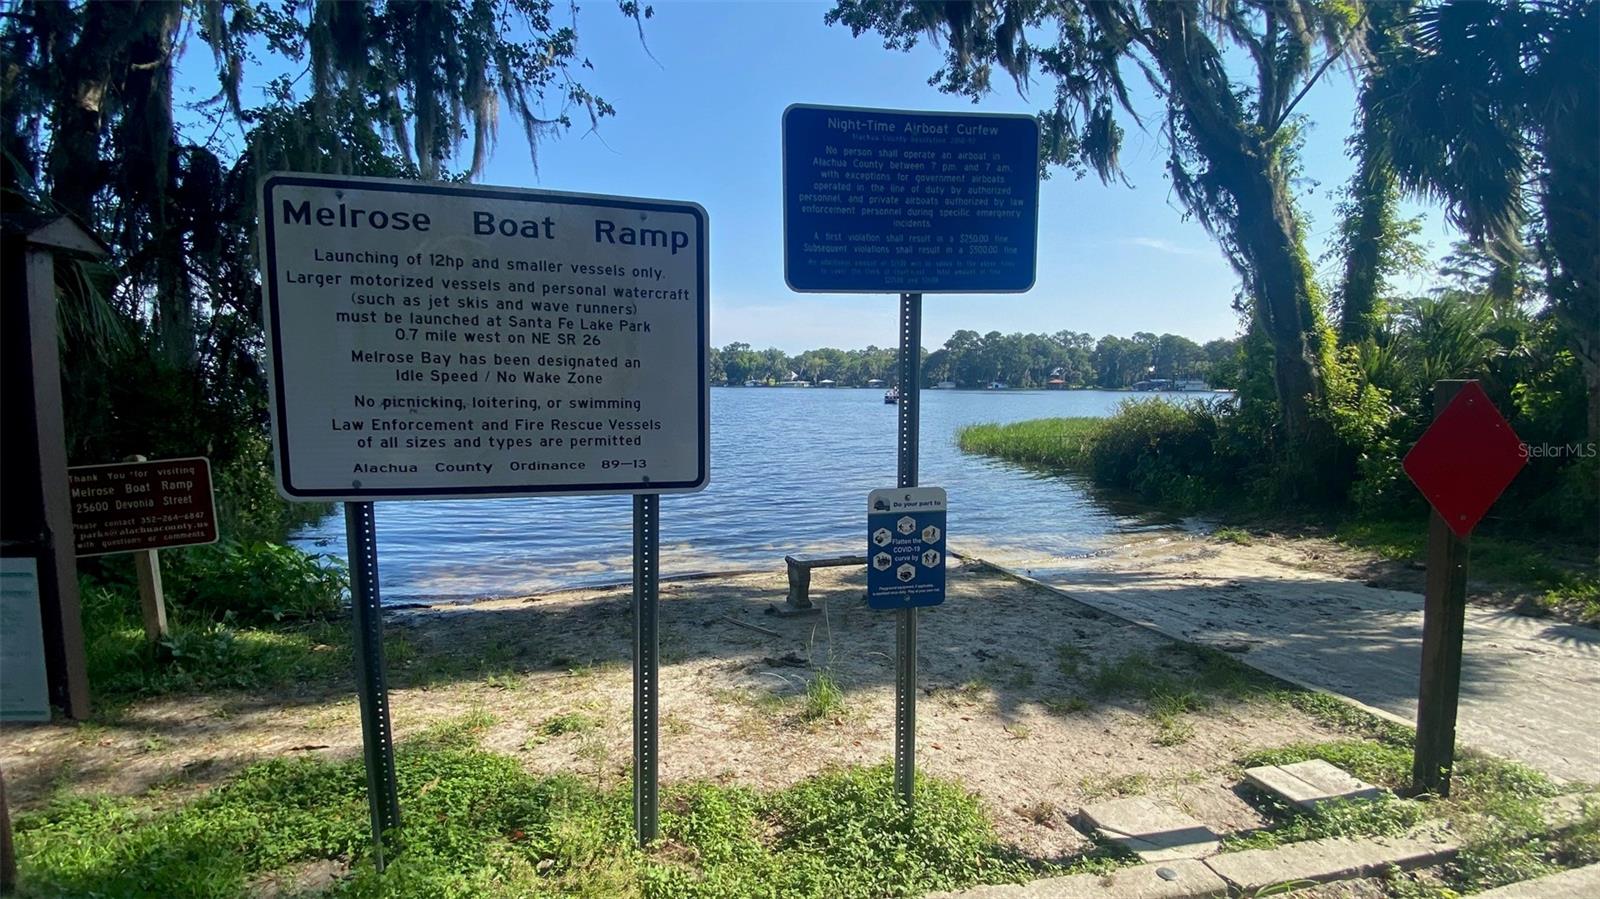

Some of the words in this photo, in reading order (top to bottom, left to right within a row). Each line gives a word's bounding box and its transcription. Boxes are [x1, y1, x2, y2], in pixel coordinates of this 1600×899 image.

[828, 118, 895, 132] Night-Time
[904, 122, 948, 134] Airboat
[957, 124, 998, 136] Curfew
[826, 146, 838, 155] No
[844, 148, 872, 157] person
[879, 149, 897, 157] shall
[904, 150, 935, 160] operate
[958, 151, 986, 160] airboat
[992, 152, 1000, 160] in
[813, 158, 847, 167] Alachua
[853, 159, 884, 170] County
[890, 161, 924, 170] between
[821, 170, 839, 178] with
[845, 171, 890, 182] exceptions
[897, 172, 908, 181] for
[916, 174, 965, 183] government
[814, 183, 850, 191] operated
[871, 183, 884, 192] the
[890, 184, 904, 192] line
[911, 184, 920, 192] of
[925, 185, 944, 194] duty
[951, 185, 961, 194] by
[968, 185, 1011, 194] authorized
[800, 193, 840, 202] personnel
[850, 194, 863, 203] and
[869, 195, 898, 204] private
[905, 195, 938, 204] airboats
[944, 196, 988, 205] authorized
[994, 197, 1003, 206] by
[1010, 197, 1023, 206] law
[802, 205, 855, 214] enforcement
[862, 207, 901, 216] personnel
[907, 208, 933, 217] during
[940, 208, 970, 217] specific
[976, 209, 1021, 218] emergency
[283, 199, 431, 233] Melrose
[473, 210, 555, 240] Boat
[595, 219, 690, 254] Ramp
[826, 233, 842, 241] first
[849, 233, 880, 242] violation
[886, 234, 903, 242] shall
[804, 243, 847, 253] Subsequent
[854, 244, 890, 254] violations
[896, 245, 913, 254] shall
[919, 246, 940, 254] result
[315, 248, 399, 267] Launching
[407, 253, 422, 266] of
[430, 254, 463, 271] 12hp
[472, 257, 499, 270] and
[507, 259, 563, 273] smaller
[571, 261, 625, 276] vessels
[632, 266, 665, 280] only.
[287, 271, 342, 288] Larger
[351, 274, 434, 289] motorized
[442, 277, 500, 292] vessels
[509, 280, 535, 293] and
[542, 282, 606, 300] personal
[614, 286, 689, 301] watercraft
[351, 294, 395, 307] (such
[403, 296, 421, 307] as
[428, 295, 450, 310] jet
[458, 296, 489, 310] skis
[496, 299, 523, 311] and
[531, 302, 568, 312] wave
[576, 302, 637, 315] runners)
[336, 312, 377, 323] must
[385, 312, 402, 324] be
[410, 313, 479, 327] launched
[487, 316, 502, 327] at
[509, 315, 553, 330] Santa
[559, 317, 574, 330] Fe
[580, 319, 614, 332] Lake
[619, 320, 651, 333] Park
[395, 328, 417, 341] 0.7
[426, 329, 456, 342] mile
[464, 330, 500, 344] west
[508, 332, 524, 344] on
[532, 332, 551, 344] NE
[558, 333, 576, 345] SR
[583, 333, 601, 346] 26
[351, 350, 413, 363] Melrose
[421, 352, 451, 367] Bay
[460, 352, 487, 365] has
[495, 354, 530, 366] been
[538, 354, 618, 370] designated
[625, 357, 641, 368] an
[396, 370, 423, 382] Idle
[430, 370, 478, 385] Speed
[485, 371, 489, 383] /
[497, 372, 517, 383] No
[524, 372, 560, 385] Wake
[567, 372, 602, 385] Zone
[354, 396, 374, 408] No
[383, 396, 466, 411] picnicking,
[472, 396, 541, 410] loitering,
[547, 398, 562, 409] or
[569, 397, 641, 412] swimming
[332, 418, 364, 431] Law
[372, 418, 474, 431] Enforcement
[481, 418, 508, 431] and
[515, 418, 544, 431] Fire
[551, 419, 602, 431] Rescue
[609, 419, 661, 431] Vessels
[357, 436, 373, 448] of
[380, 436, 398, 448] all
[406, 436, 446, 448] sizes
[454, 436, 481, 448] and
[489, 436, 532, 449] types
[540, 437, 563, 447] are
[570, 435, 641, 450] permitted
[353, 463, 418, 473] Alachua
[435, 462, 493, 474] County
[510, 459, 585, 471] Ordinance
[69, 474, 98, 483] Thank
[108, 472, 125, 480] You
[157, 467, 195, 476] visiting
[72, 487, 115, 498] Melrose
[125, 483, 150, 494] Boat
[162, 480, 193, 491] Ramp
[76, 502, 108, 513] 25600
[116, 499, 154, 510] Devonia
[163, 495, 192, 506] Street
[104, 518, 135, 527] contact
[102, 536, 141, 547] questions
[164, 531, 205, 541] comments
